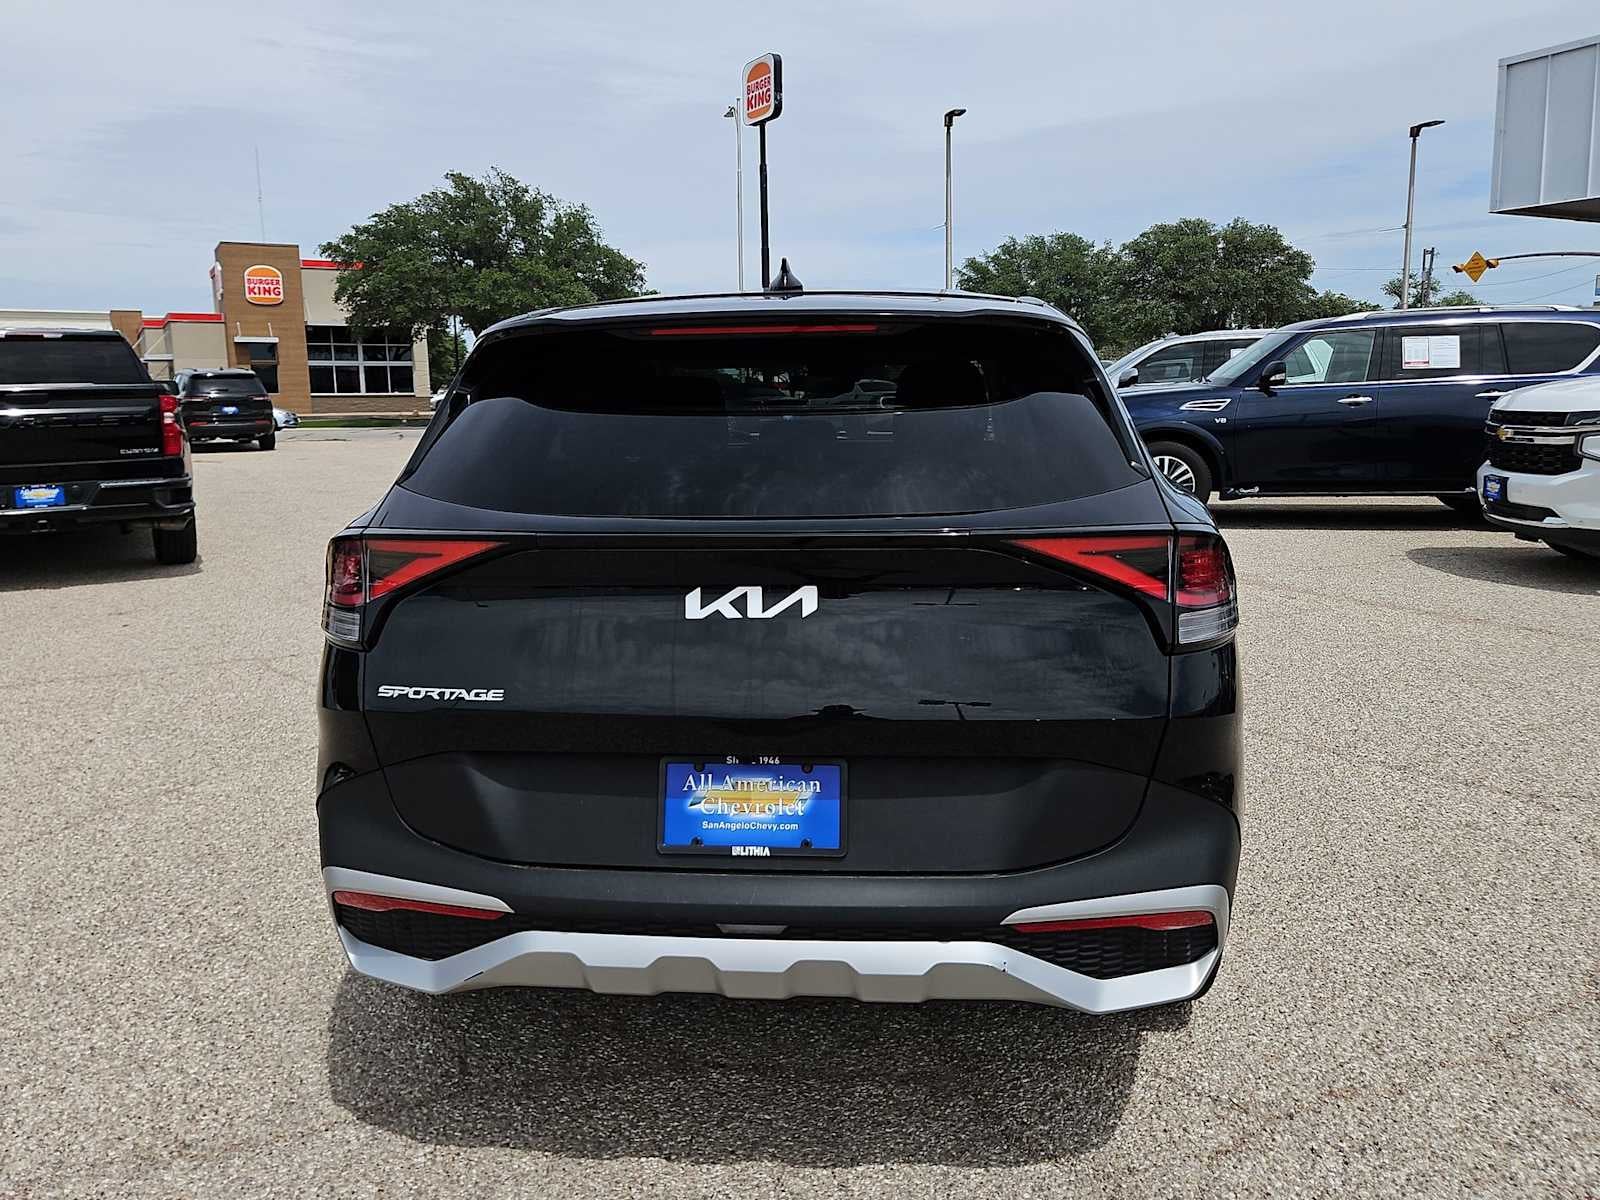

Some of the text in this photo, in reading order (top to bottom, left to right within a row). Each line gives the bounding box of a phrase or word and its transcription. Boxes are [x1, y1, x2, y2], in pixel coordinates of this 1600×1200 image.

[746, 75, 771, 95] BURGER
[746, 87, 771, 111] KING
[246, 278, 281, 286] BURGER
[247, 286, 282, 296] KING
[685, 586, 818, 619] KIA
[377, 685, 505, 701] SPORTAGE
[759, 756, 780, 765] 1946
[682, 773, 822, 793] All American
[701, 794, 805, 816] Chevrolet
[702, 821, 799, 832] SanAngeloChevy.com
[740, 845, 771, 857] LITHIA
